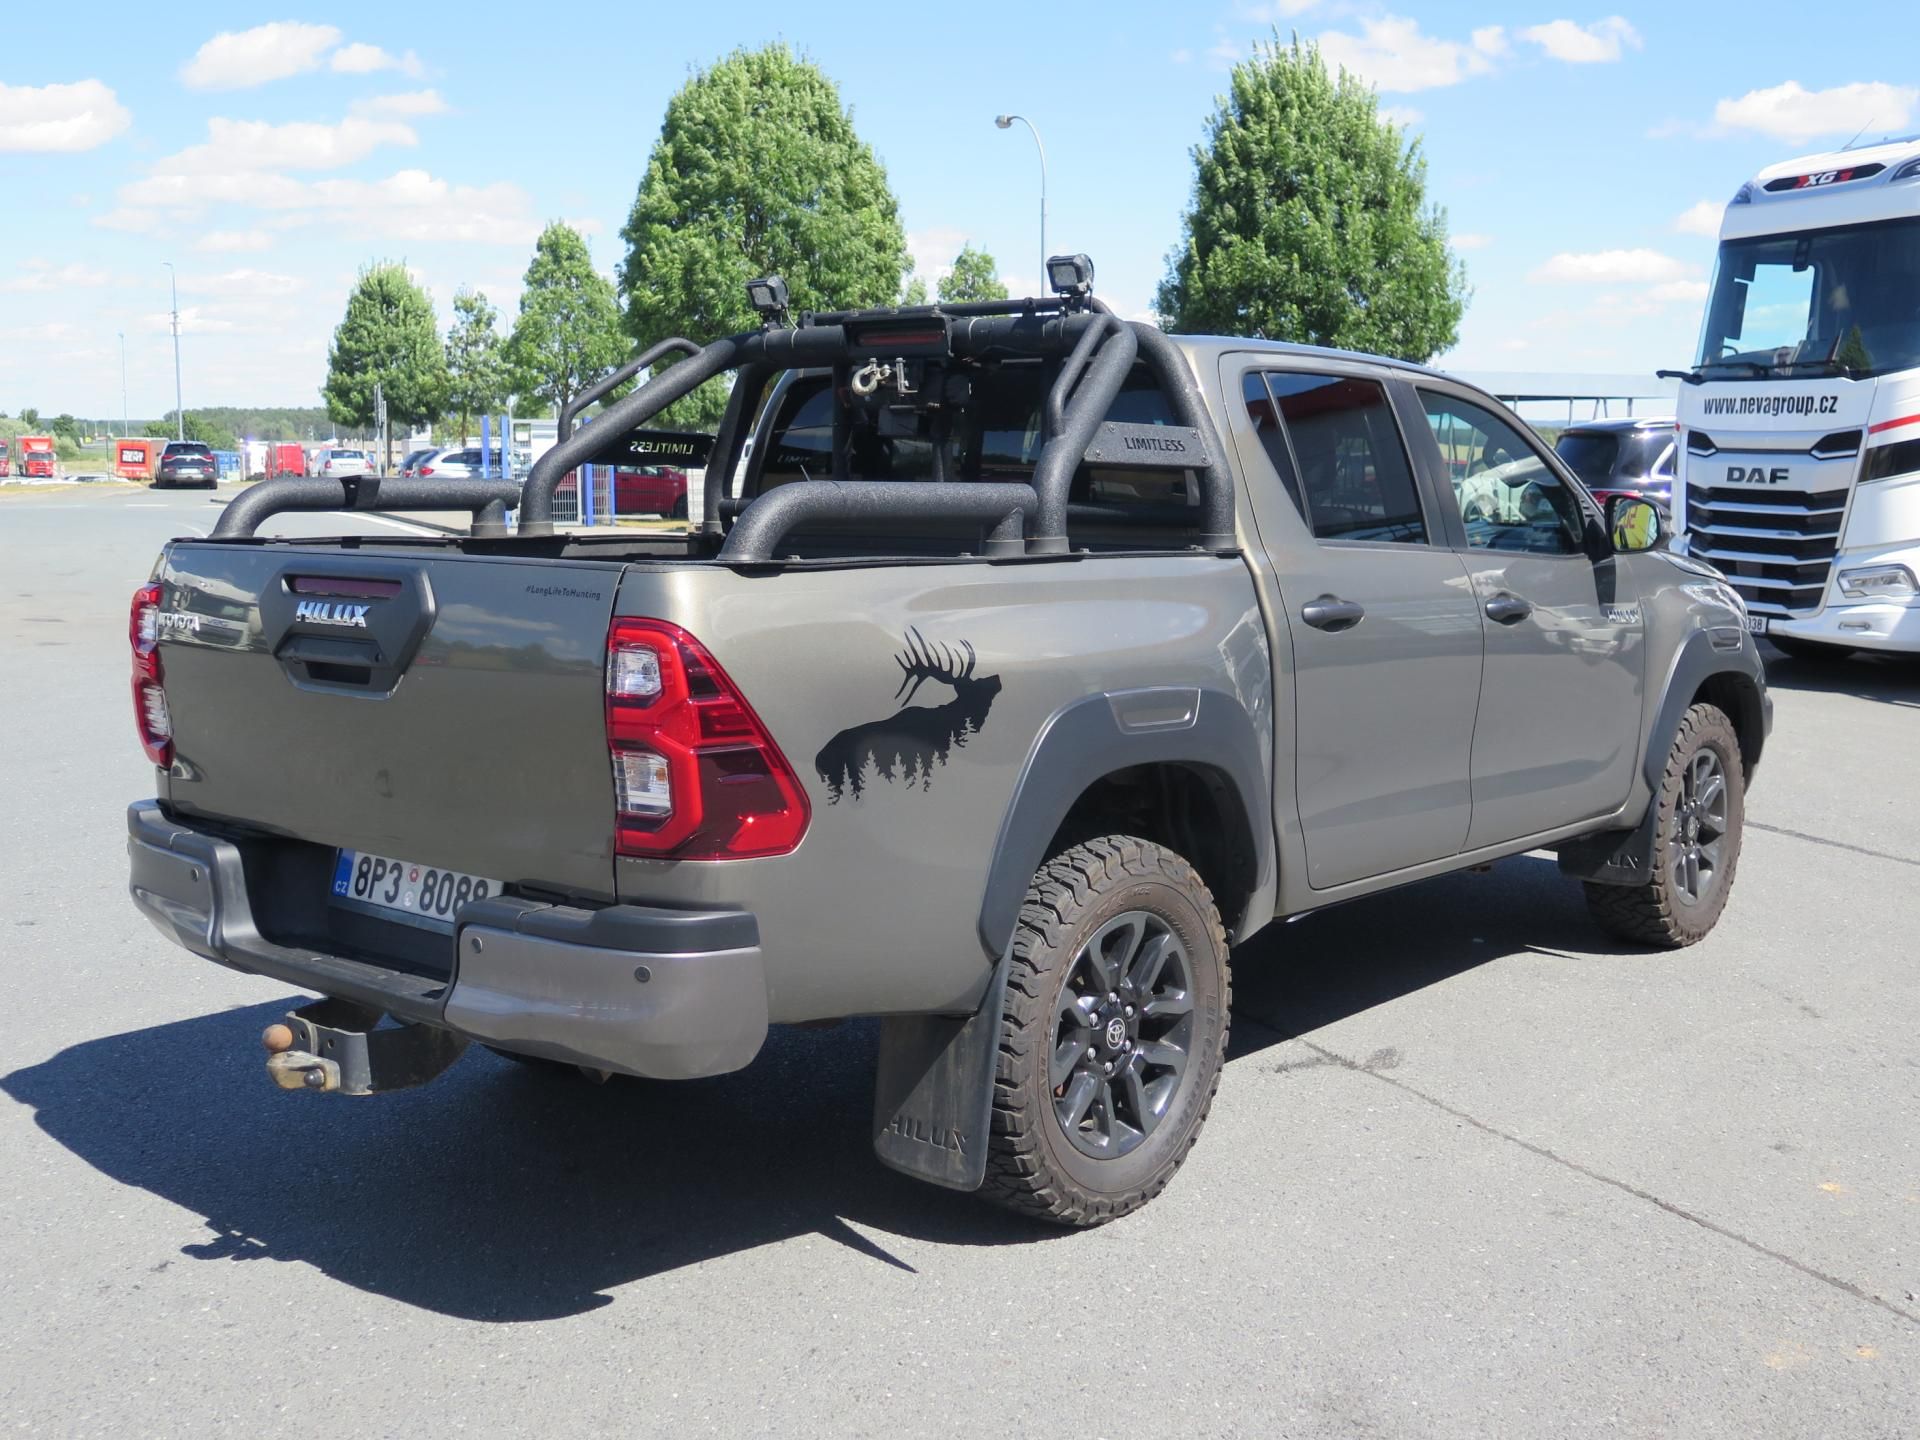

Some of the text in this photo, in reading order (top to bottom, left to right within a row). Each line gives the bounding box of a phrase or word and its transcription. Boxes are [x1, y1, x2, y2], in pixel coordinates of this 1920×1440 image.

[1703, 395, 1839, 416] www.nevagroup.cz
[1124, 437, 1186, 451] LIMITLESS
[1726, 466, 1790, 484] DAF
[525, 584, 601, 601] #LongLifeToHunting
[295, 600, 371, 628] HILUX
[335, 880, 347, 893] CZ
[354, 856, 403, 904] 8P3
